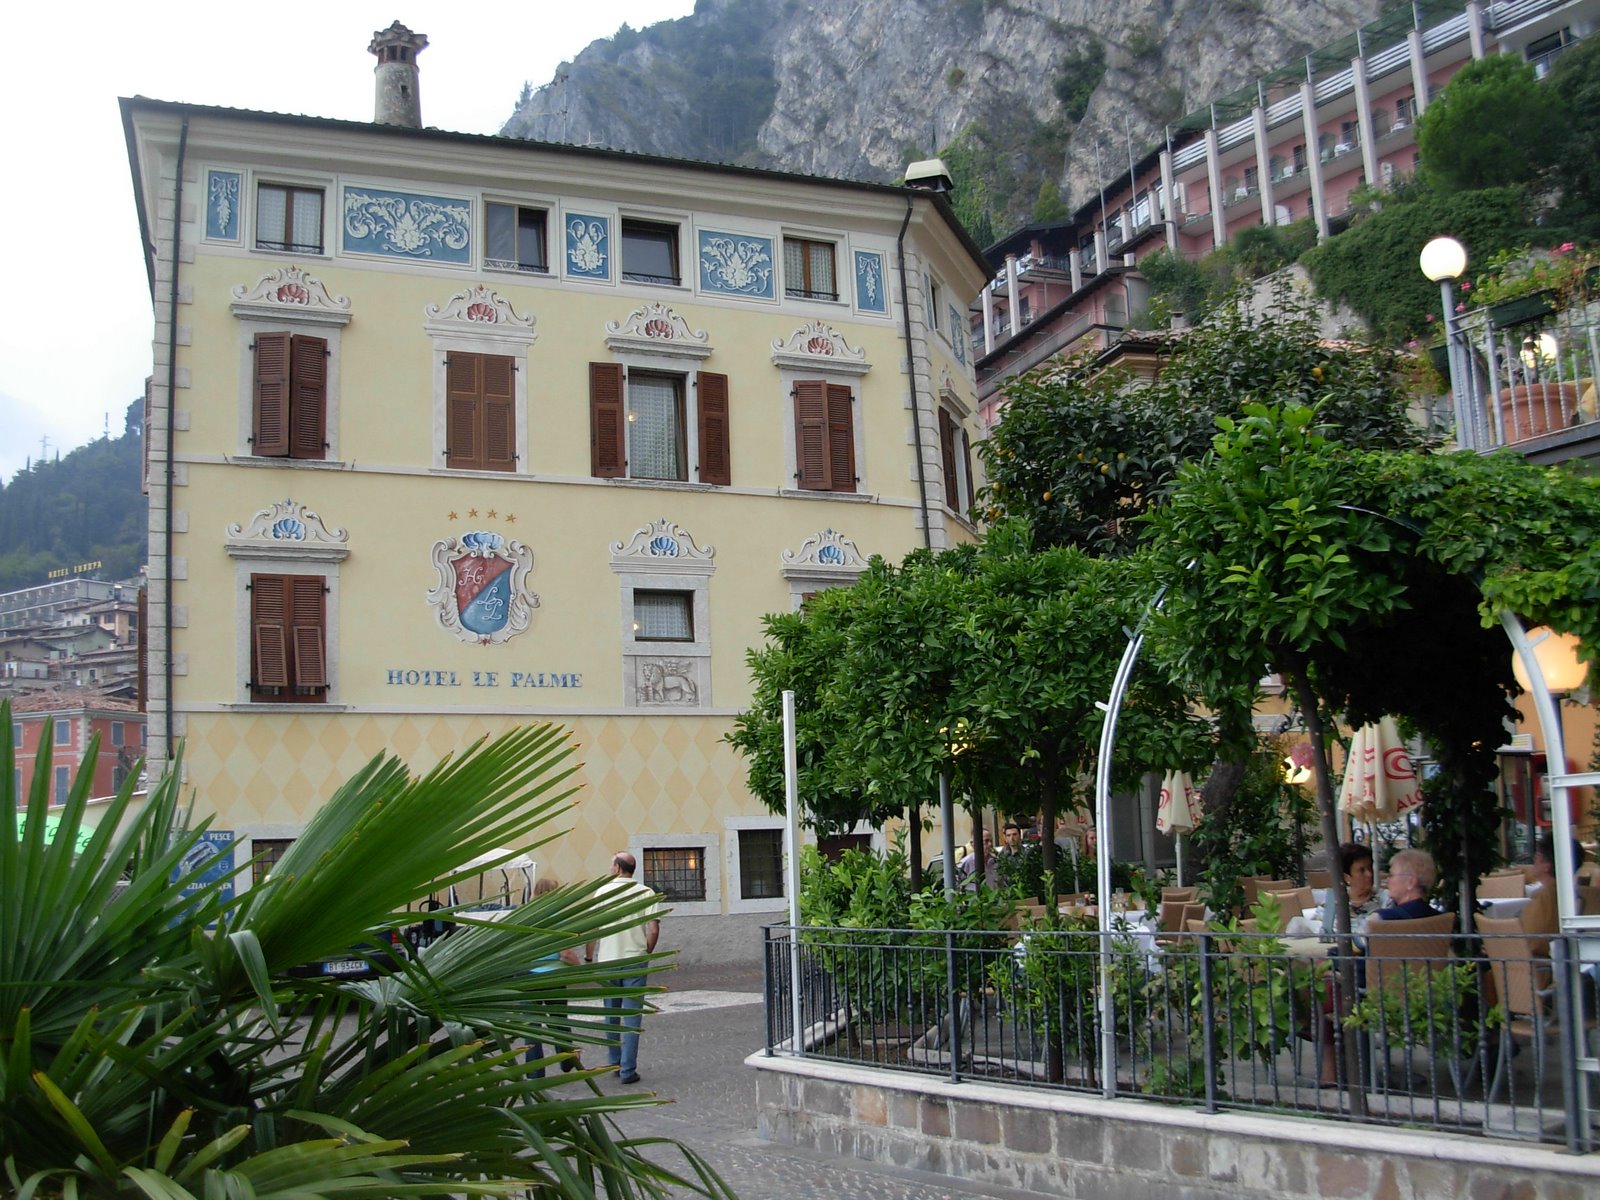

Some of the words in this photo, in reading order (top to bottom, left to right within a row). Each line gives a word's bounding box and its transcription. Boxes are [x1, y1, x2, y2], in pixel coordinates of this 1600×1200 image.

[386, 669, 462, 687] HOTEL
[472, 671, 499, 687] LE
[510, 672, 583, 688] PALME
[209, 833, 232, 841] PESCE
